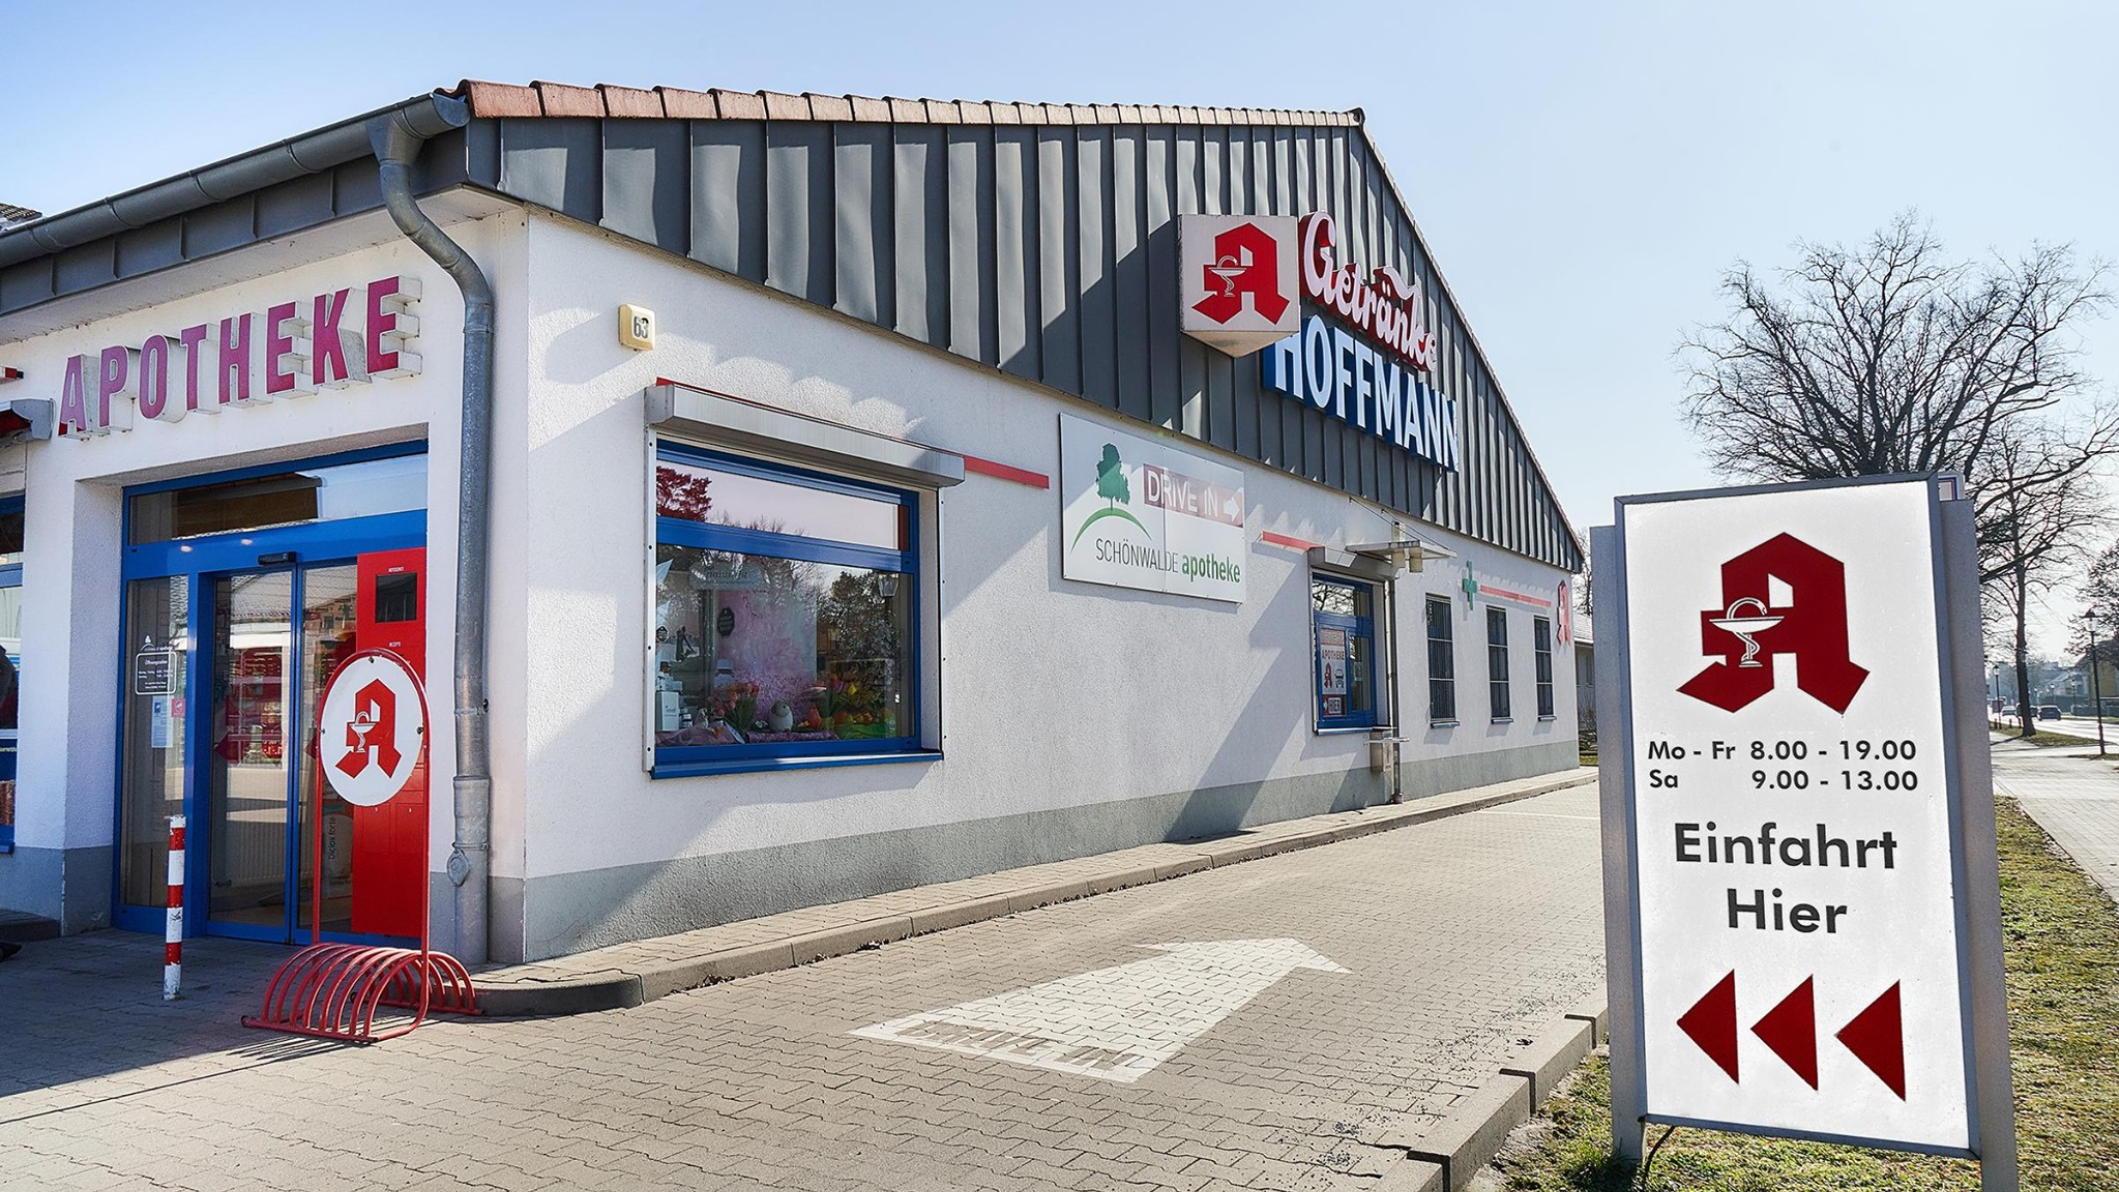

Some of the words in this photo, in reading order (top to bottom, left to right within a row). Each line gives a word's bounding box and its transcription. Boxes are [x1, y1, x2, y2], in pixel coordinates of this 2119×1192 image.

[1301, 210, 1438, 373] Getränke
[633, 316, 649, 339] 63
[58, 275, 402, 438] APOTHEKE
[1275, 314, 1459, 473] HOFFMANN
[1147, 468, 1198, 513] DRIVE
[1203, 485, 1219, 518] IN
[1095, 538, 1179, 574] SCHÖNWALDE
[1181, 553, 1241, 583] apotheke
[1648, 740, 1686, 760] Mo
[1712, 740, 1736, 760] Fr
[1750, 740, 1808, 760] 8.00
[1839, 740, 1917, 761] 19.00
[1649, 769, 1679, 788] Sa
[1751, 770, 1809, 790] 9.00
[1841, 770, 1918, 791] 13.00
[1675, 821, 1898, 869] Einfahrt
[1727, 887, 1848, 934] Hier
